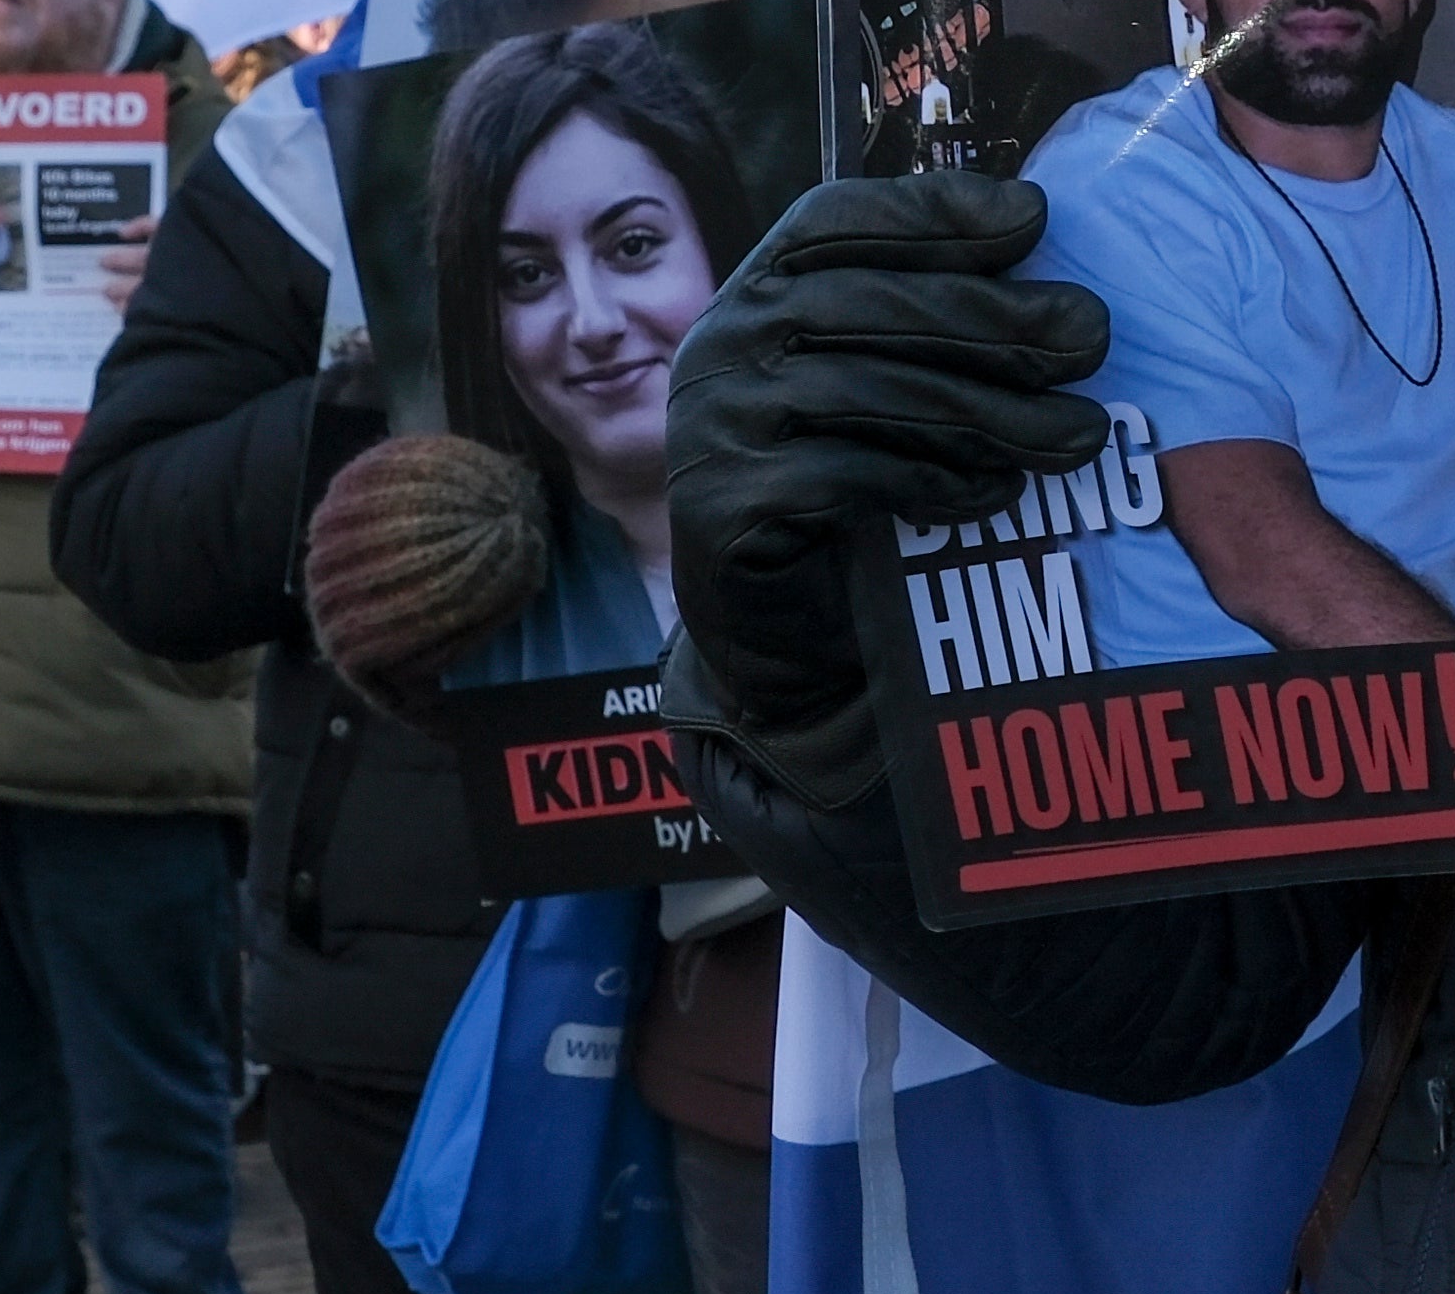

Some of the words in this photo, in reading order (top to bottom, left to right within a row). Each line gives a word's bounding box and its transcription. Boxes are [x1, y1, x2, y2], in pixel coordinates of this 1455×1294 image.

[905, 551, 1094, 695] HIM
[654, 815, 693, 854] by
[937, 691, 1205, 840] HOME
